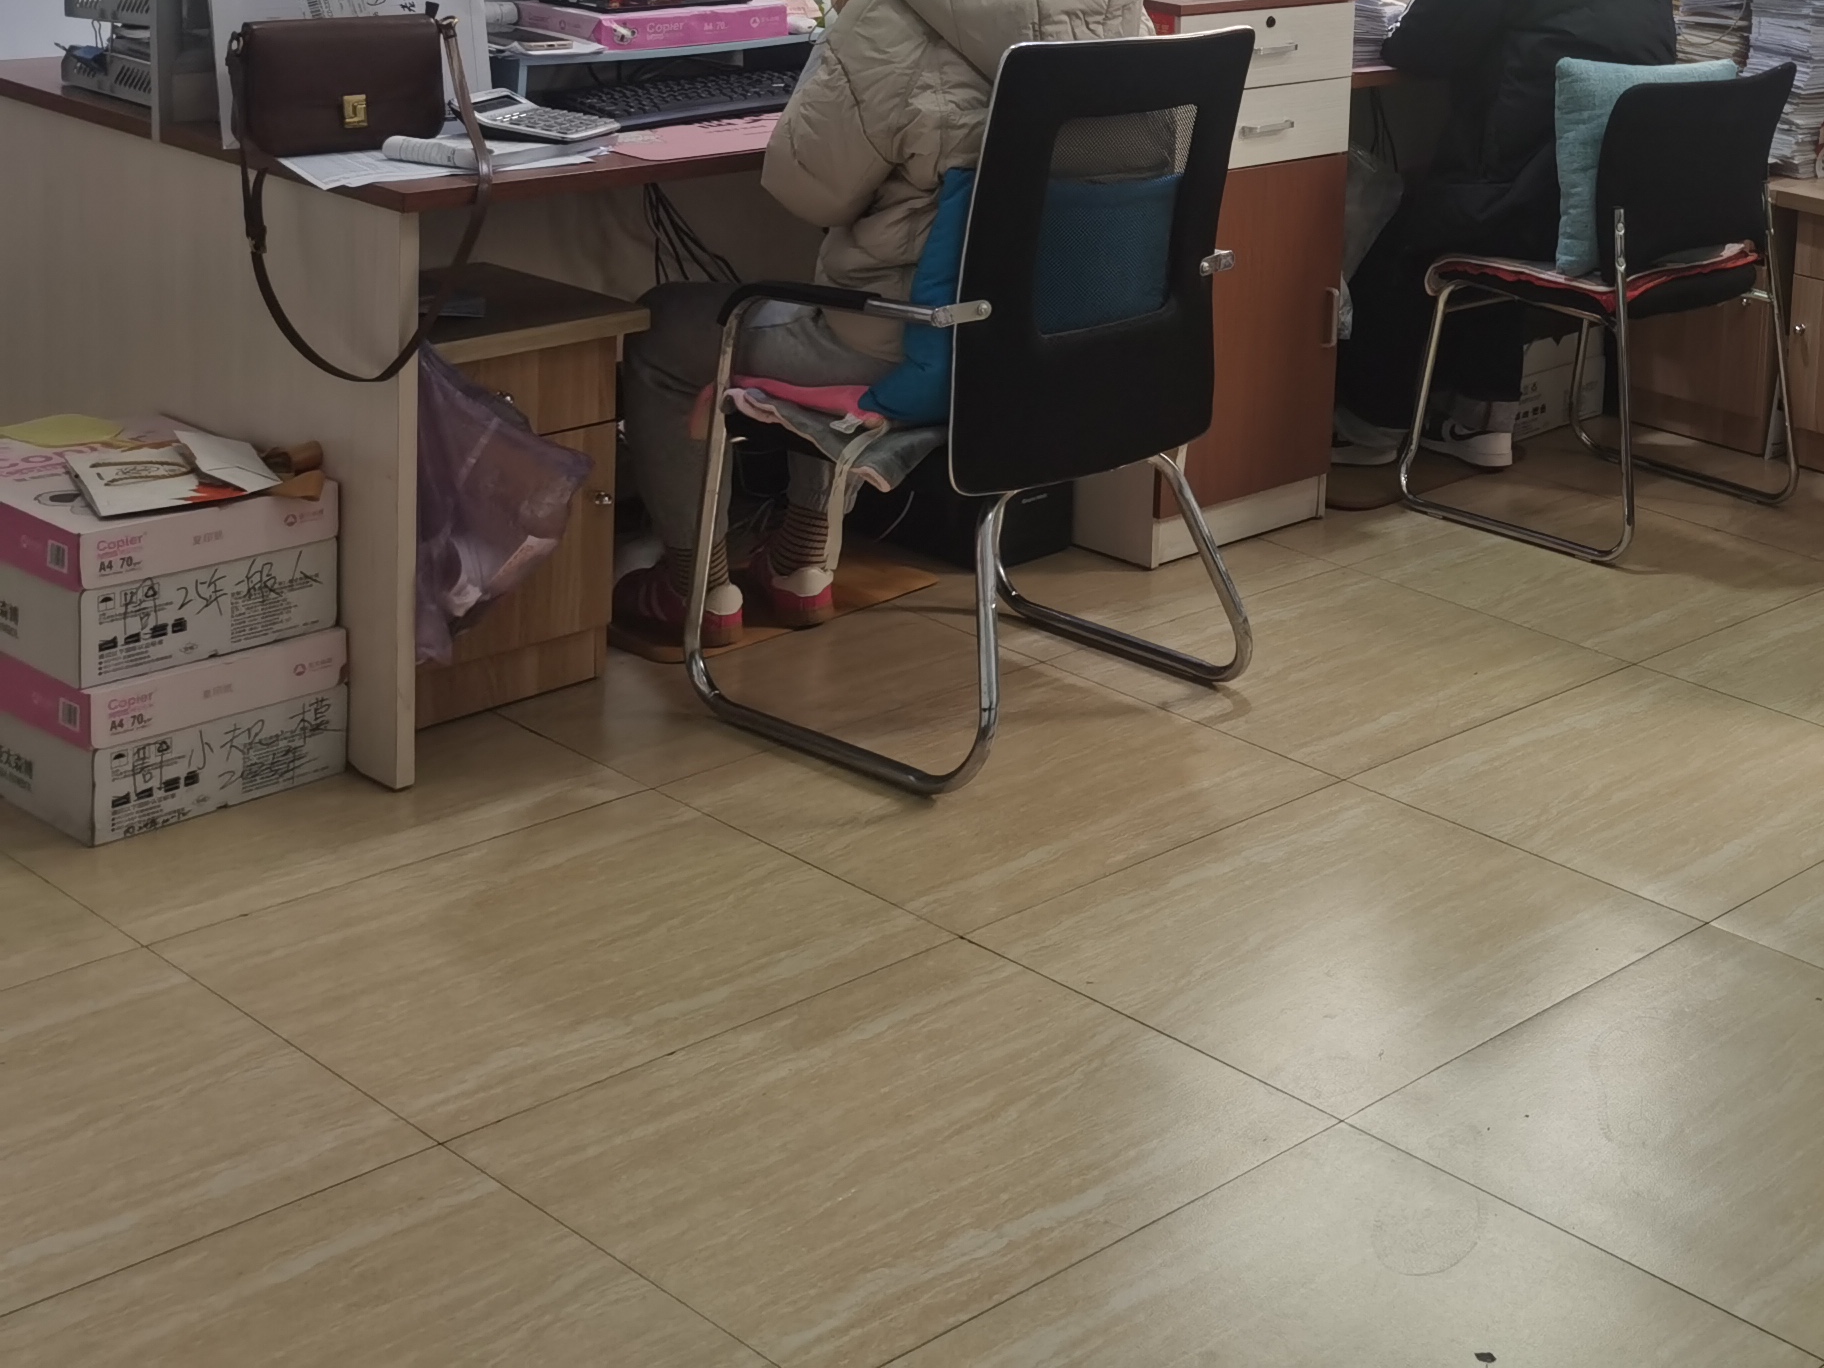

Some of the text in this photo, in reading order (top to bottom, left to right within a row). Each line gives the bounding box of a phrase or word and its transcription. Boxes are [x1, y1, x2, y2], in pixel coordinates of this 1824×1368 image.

[646, 21, 685, 34] Copier
[96, 534, 145, 552] Copier
[99, 560, 114, 573] A4
[107, 691, 154, 711] Copier
[110, 719, 125, 732] A4
